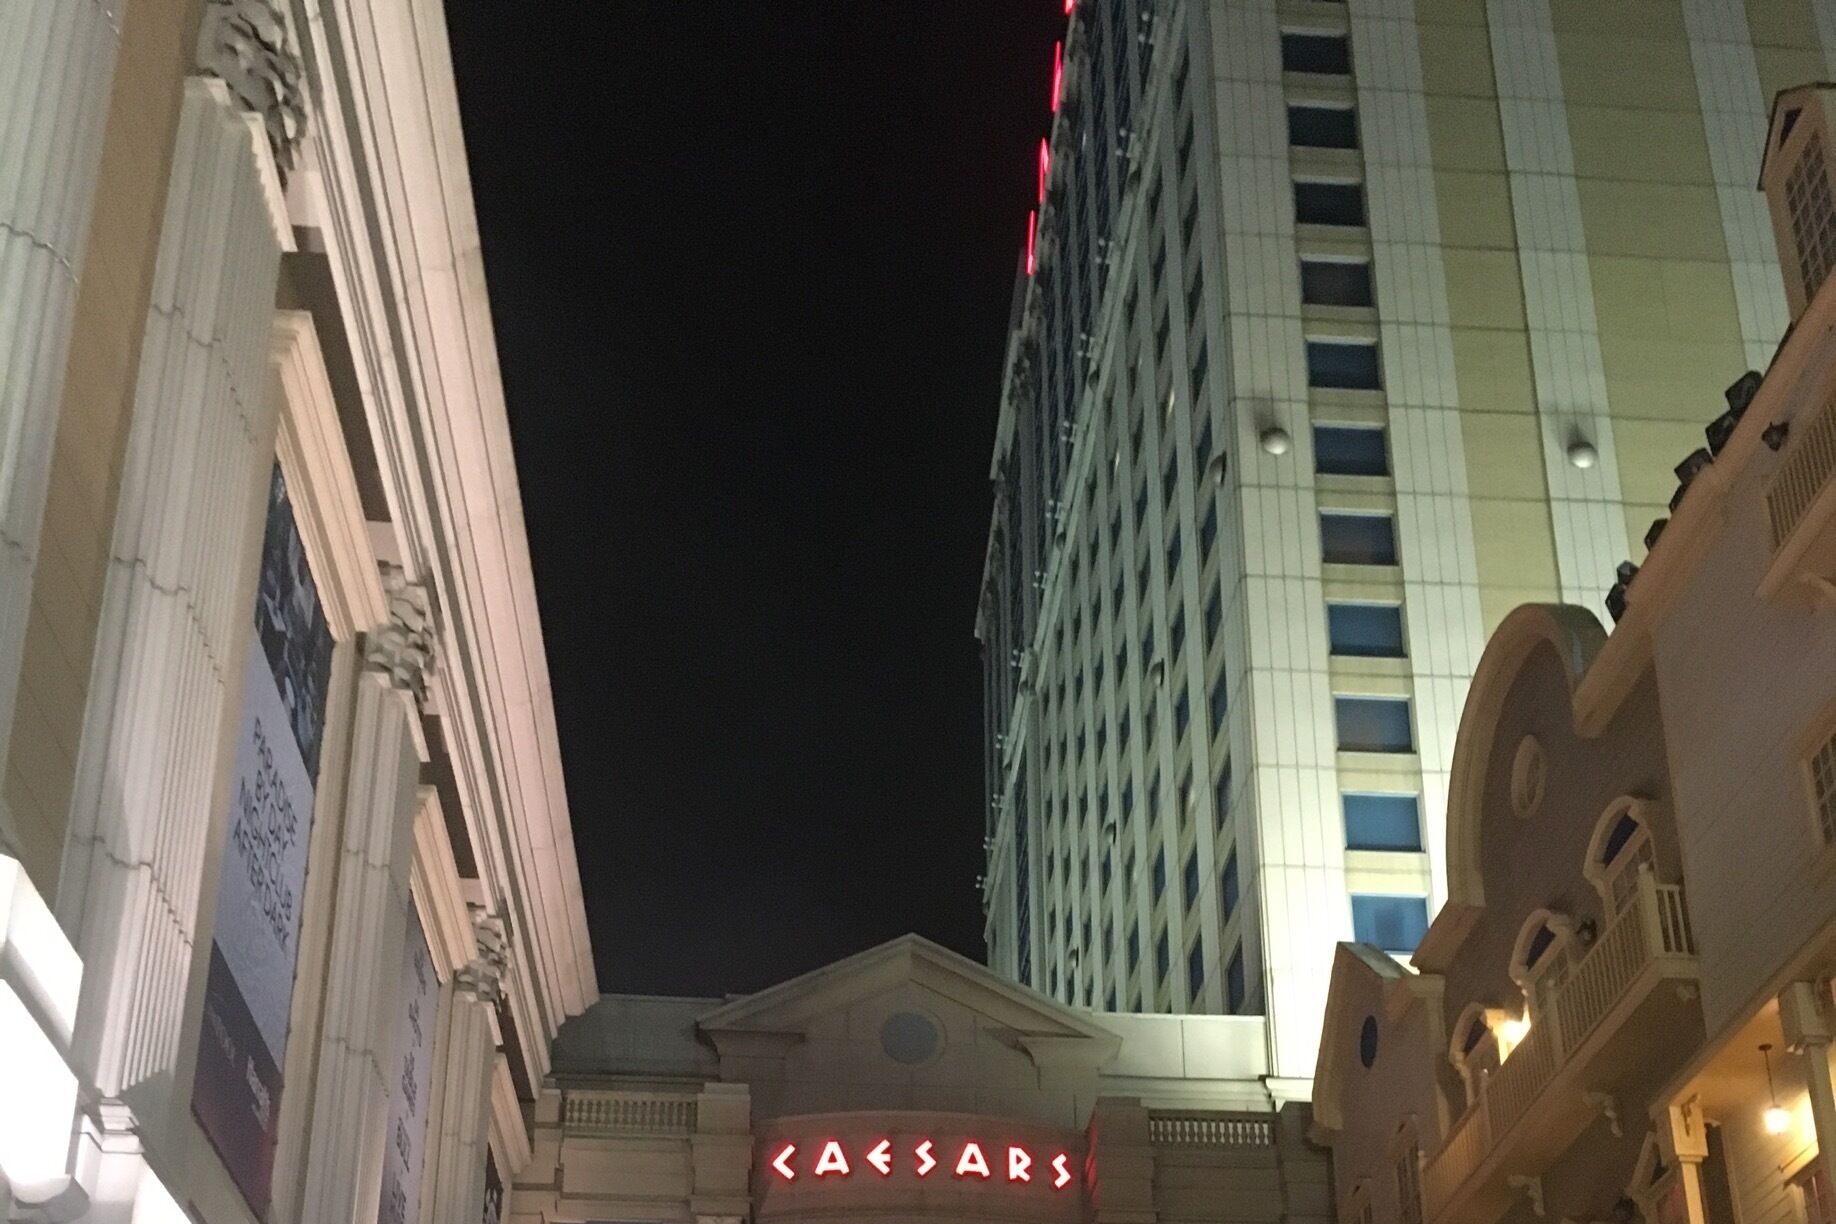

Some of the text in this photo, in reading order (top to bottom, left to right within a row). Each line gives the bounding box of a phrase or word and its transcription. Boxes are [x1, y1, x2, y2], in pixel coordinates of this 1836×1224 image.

[253, 716, 298, 847] PARADISE
[255, 769, 288, 861] BY DAY
[233, 817, 290, 958] AFTER DARK
[239, 775, 293, 922] NIGHTCLUB
[771, 1138, 1073, 1190] CAESARS
